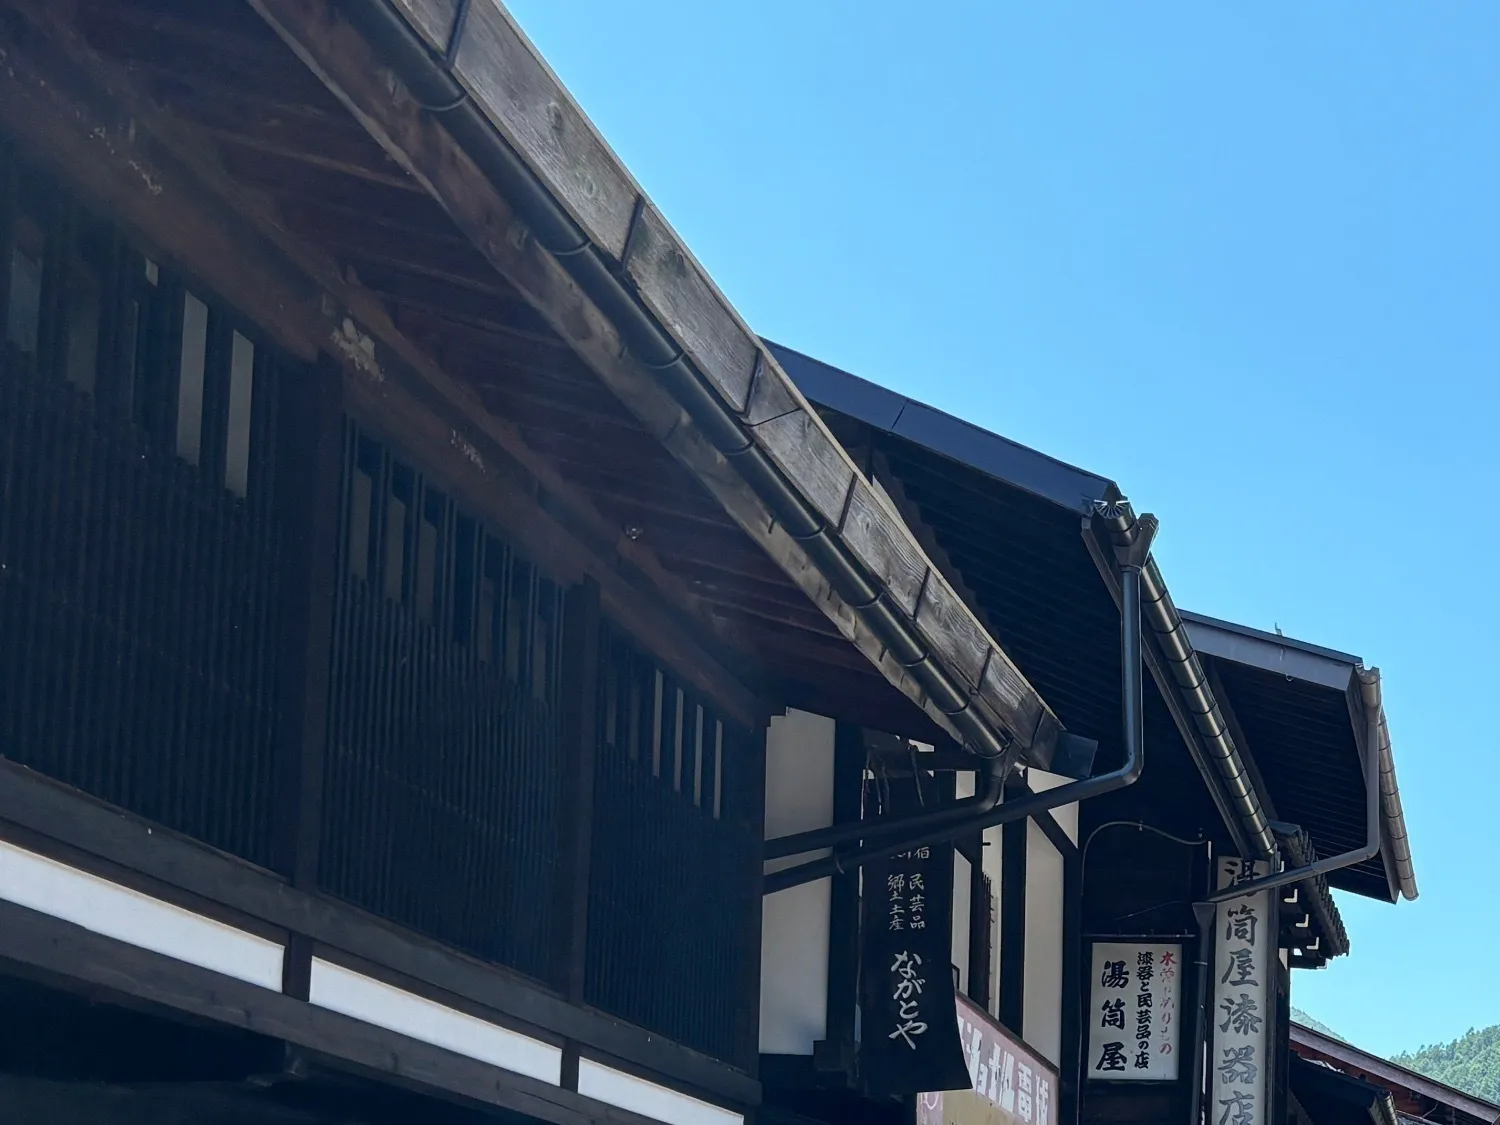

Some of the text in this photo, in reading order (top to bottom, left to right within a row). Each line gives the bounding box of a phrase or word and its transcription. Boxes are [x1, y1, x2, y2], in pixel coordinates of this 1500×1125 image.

[909, 873, 926, 929] 民芸品
[888, 950, 928, 1050] ながとや
[1095, 960, 1129, 1071] 湯筒屋
[1134, 951, 1154, 1069] 漆器と民芸品の店
